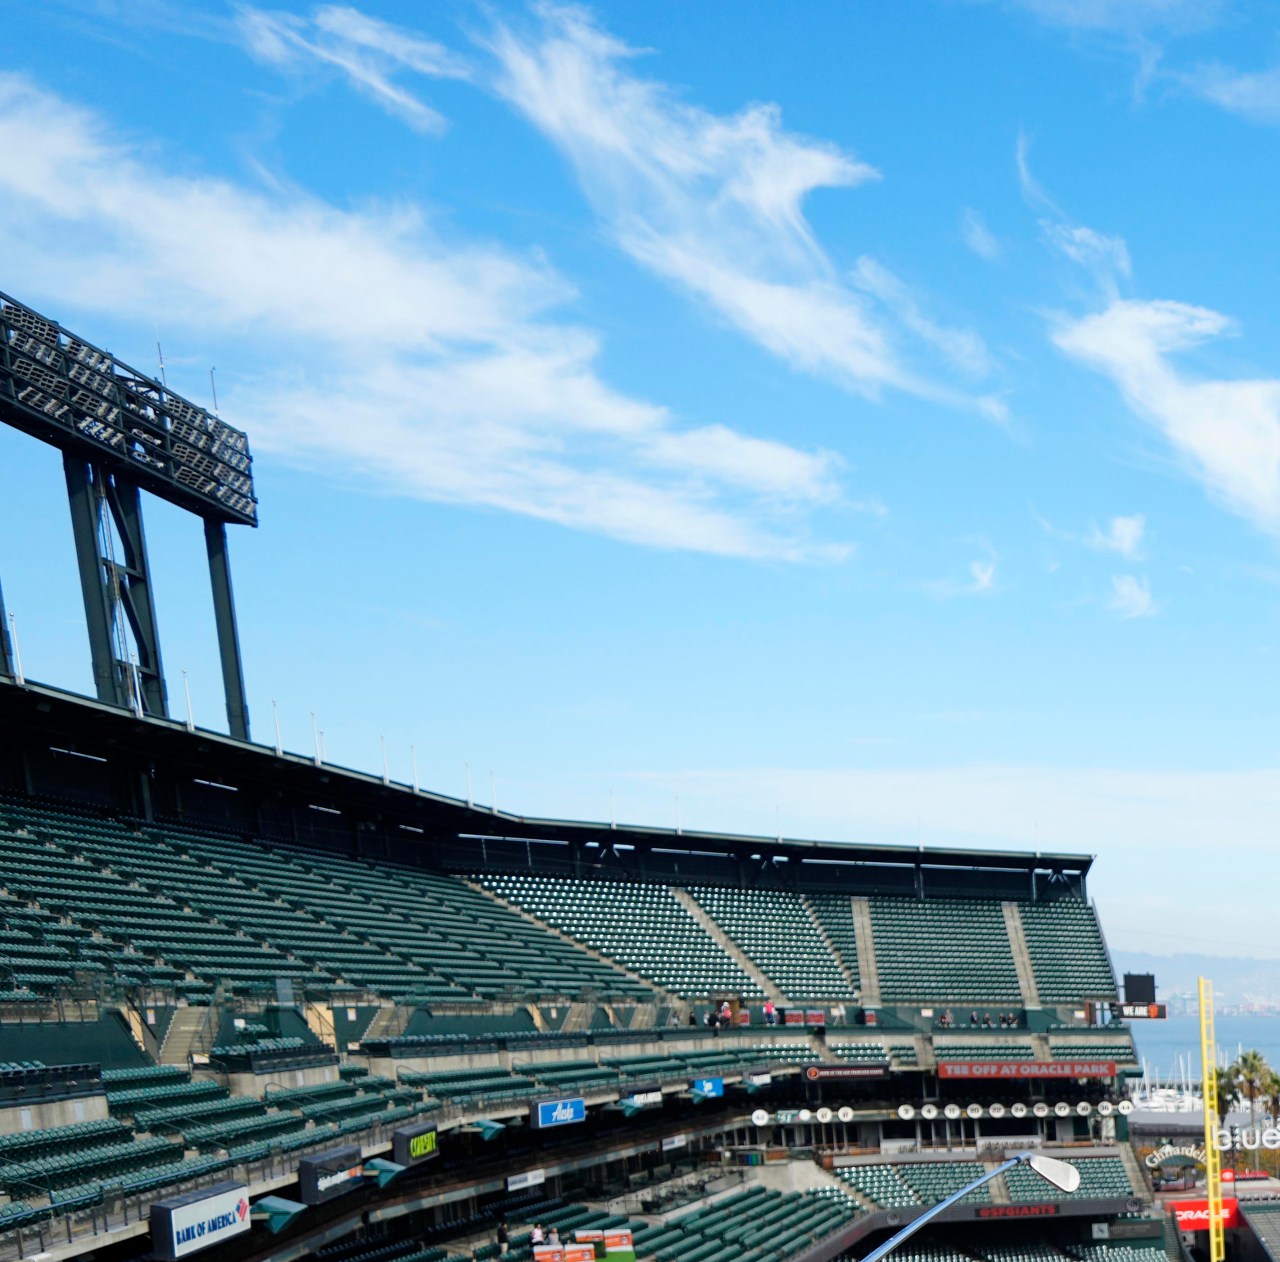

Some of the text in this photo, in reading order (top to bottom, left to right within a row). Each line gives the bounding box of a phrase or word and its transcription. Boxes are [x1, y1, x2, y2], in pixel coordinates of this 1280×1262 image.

[1123, 1005, 1148, 1016] WE ARE
[945, 1064, 1110, 1075] TEE OFF AT ORACLE PARK
[979, 1204, 1056, 1218] @SFGIANTS
[176, 1210, 237, 1245] BANK OF AMERICA
